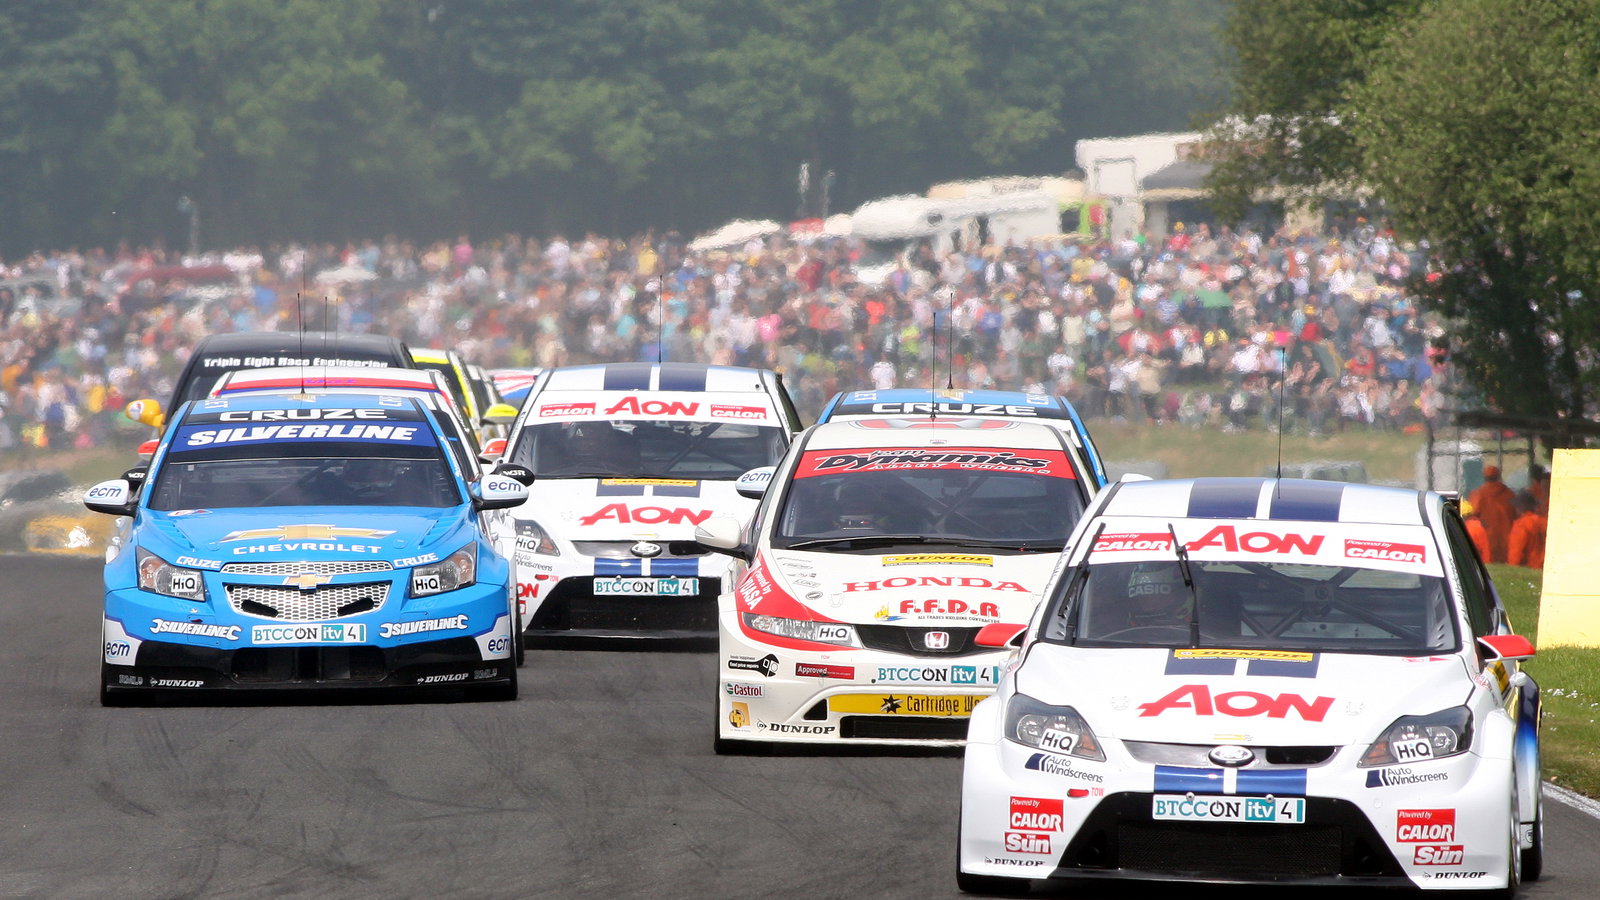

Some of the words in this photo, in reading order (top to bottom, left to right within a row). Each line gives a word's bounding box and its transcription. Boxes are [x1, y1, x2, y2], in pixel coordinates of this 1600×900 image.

[204, 357, 240, 367] Triple
[244, 357, 276, 367] Eight
[278, 358, 310, 366] Race
[313, 357, 388, 368] Engineering
[541, 408, 594, 417] CALOR
[604, 396, 700, 416] AON
[872, 402, 1037, 416] CRUZE
[219, 408, 387, 421] CRUZE
[714, 410, 766, 419] CALOR
[741, 473, 772, 482] ecm
[89, 487, 122, 497] ecm
[488, 482, 521, 492] ecm
[578, 503, 714, 526] AON
[1094, 540, 1168, 551] CALOR
[1185, 525, 1325, 555] AON
[233, 543, 382, 555] CHEVROLET
[1346, 547, 1425, 564] CALOR
[176, 555, 222, 568] CRUZE
[393, 552, 439, 567] CRUZE
[173, 578, 195, 589] HiQ
[415, 577, 439, 591] HiQ
[842, 577, 1032, 593] HONDA
[1128, 584, 1171, 598] CASIO
[819, 626, 848, 639] HiQ
[106, 642, 130, 656] ecm
[797, 666, 827, 674] Approved
[158, 679, 204, 687] DUNLOP
[425, 673, 469, 683] DUNLOP
[734, 684, 763, 696] Castrol
[907, 696, 959, 716] Cartridge
[1136, 684, 1336, 722] AON
[769, 723, 836, 734] DUNLOP
[1042, 732, 1072, 751] HiQ
[1397, 742, 1430, 759] HiQ
[1049, 756, 1071, 767] Auto
[1046, 763, 1104, 783] Windscreens
[1387, 767, 1412, 775] Auto
[1388, 772, 1448, 786] Windscreens
[1091, 787, 1104, 797] TOW
[1032, 799, 1040, 808] by
[1012, 812, 1062, 832] CALOR
[1399, 811, 1424, 819] Powered
[1425, 811, 1432, 820] by
[1398, 824, 1454, 843] CALOR
[1006, 834, 1050, 853] Sun
[1415, 847, 1463, 864] Sun
[994, 859, 1046, 867] DUNLOP
[1435, 871, 1488, 879] DUNLOP
